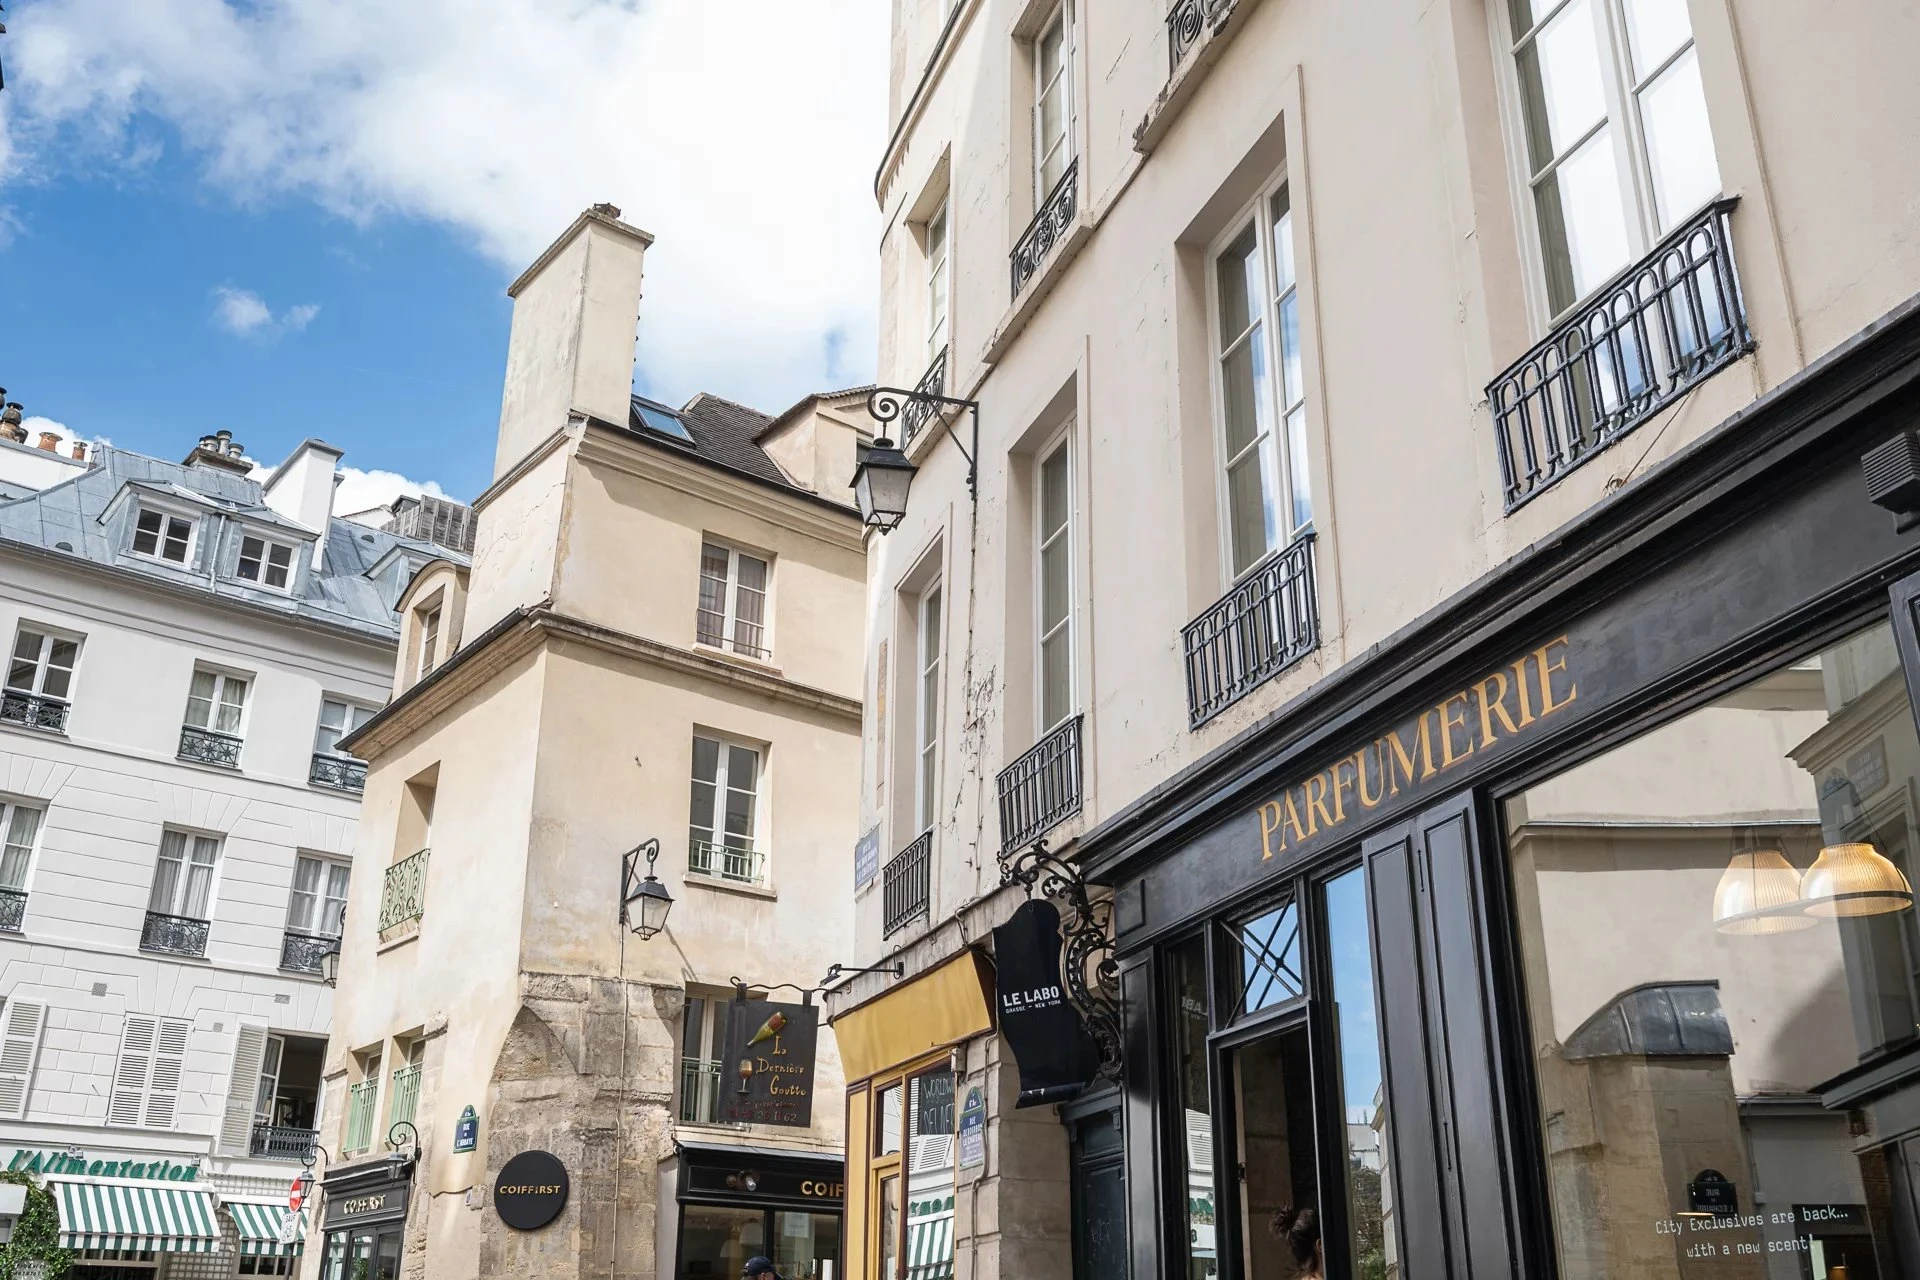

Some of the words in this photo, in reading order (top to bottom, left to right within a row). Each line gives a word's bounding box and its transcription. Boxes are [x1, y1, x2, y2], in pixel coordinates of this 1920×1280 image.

[1256, 633, 1578, 863] PARFUMERIE
[1003, 993, 1021, 1007] LE
[1024, 986, 1060, 1003] LABO
[1005, 1006, 1026, 1014] GRASSE
[771, 1035, 787, 1055] La
[769, 1075, 807, 1096] Goutte
[1655, 1221, 1682, 1236] City
[1690, 1213, 1764, 1231] Exclusives
[1771, 1211, 1795, 1224] are
[1687, 1242, 1716, 1258] with
[1723, 1245, 1730, 1255] a
[1737, 1241, 1760, 1255] new
